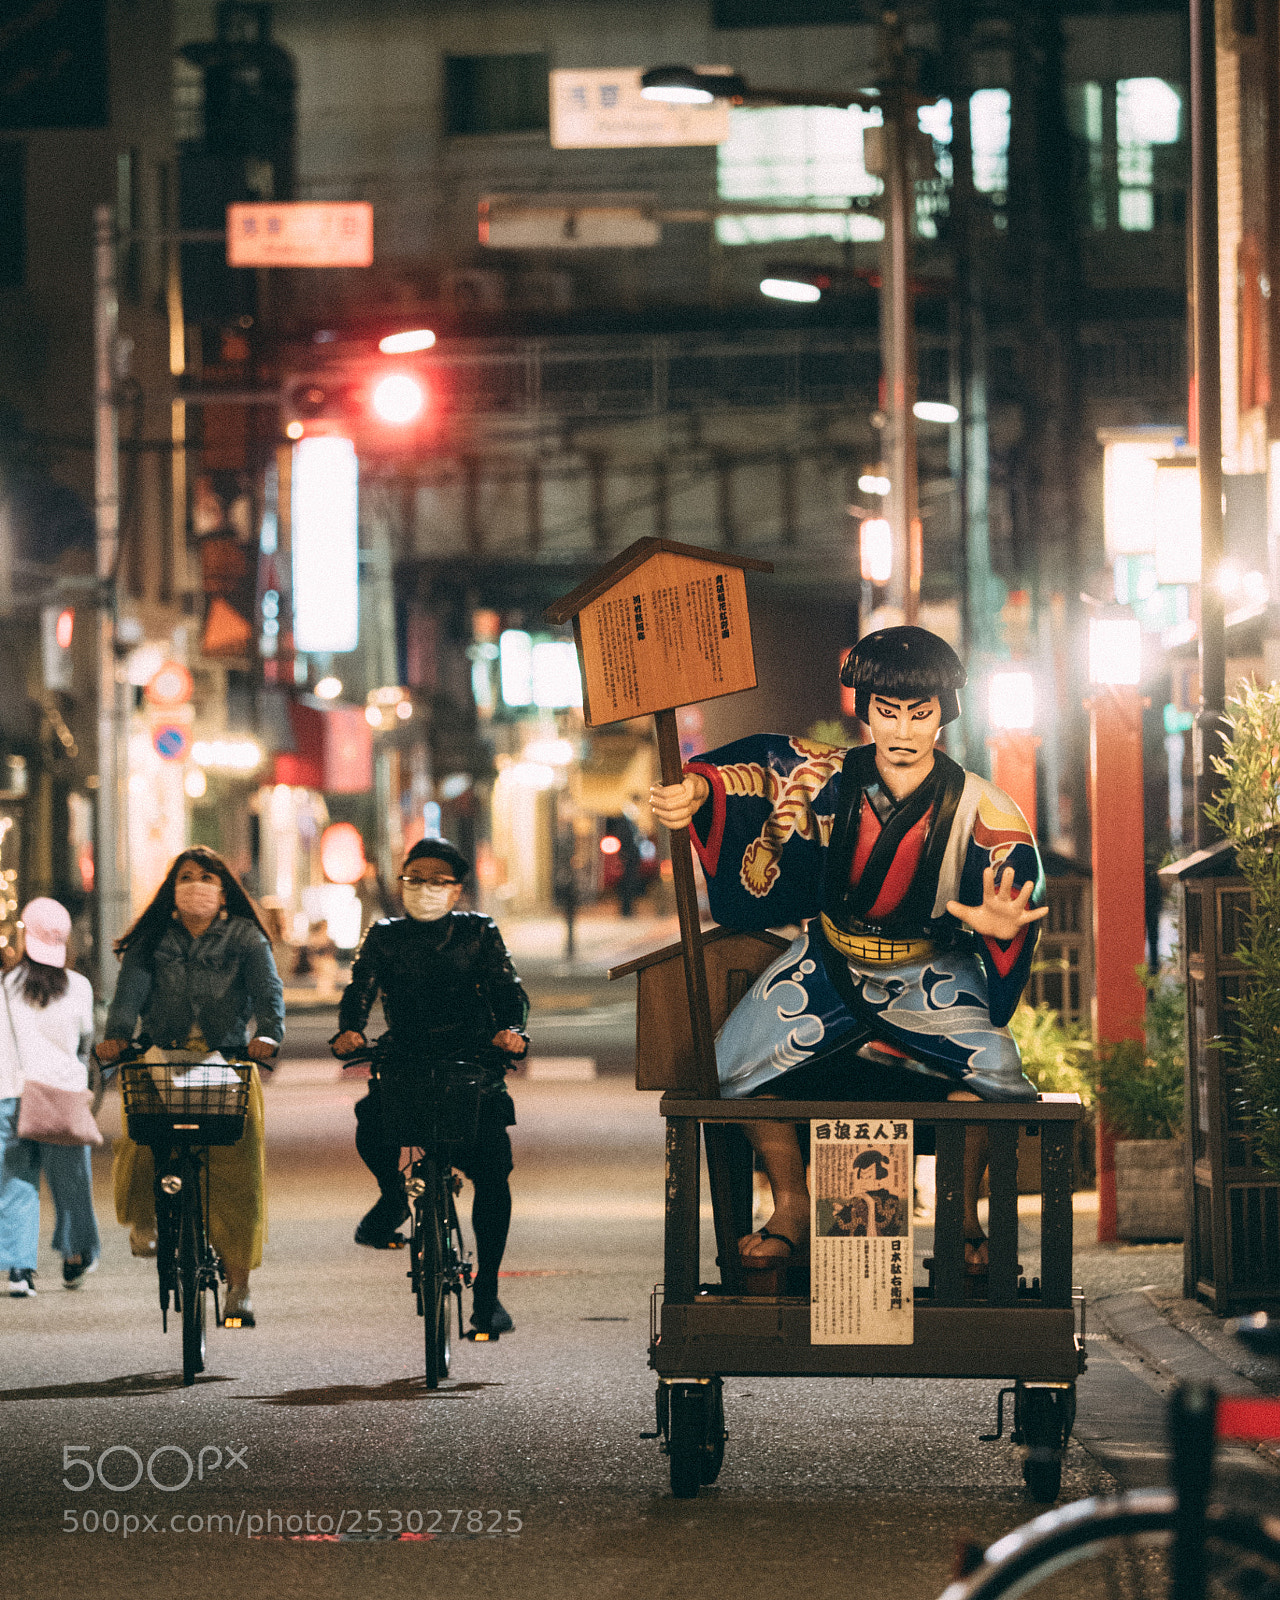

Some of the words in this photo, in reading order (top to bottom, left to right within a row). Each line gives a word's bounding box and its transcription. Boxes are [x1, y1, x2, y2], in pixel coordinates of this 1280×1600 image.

[815, 1122, 908, 1140] 白浪五人男
[890, 1239, 903, 1311] 日本駄右衛門
